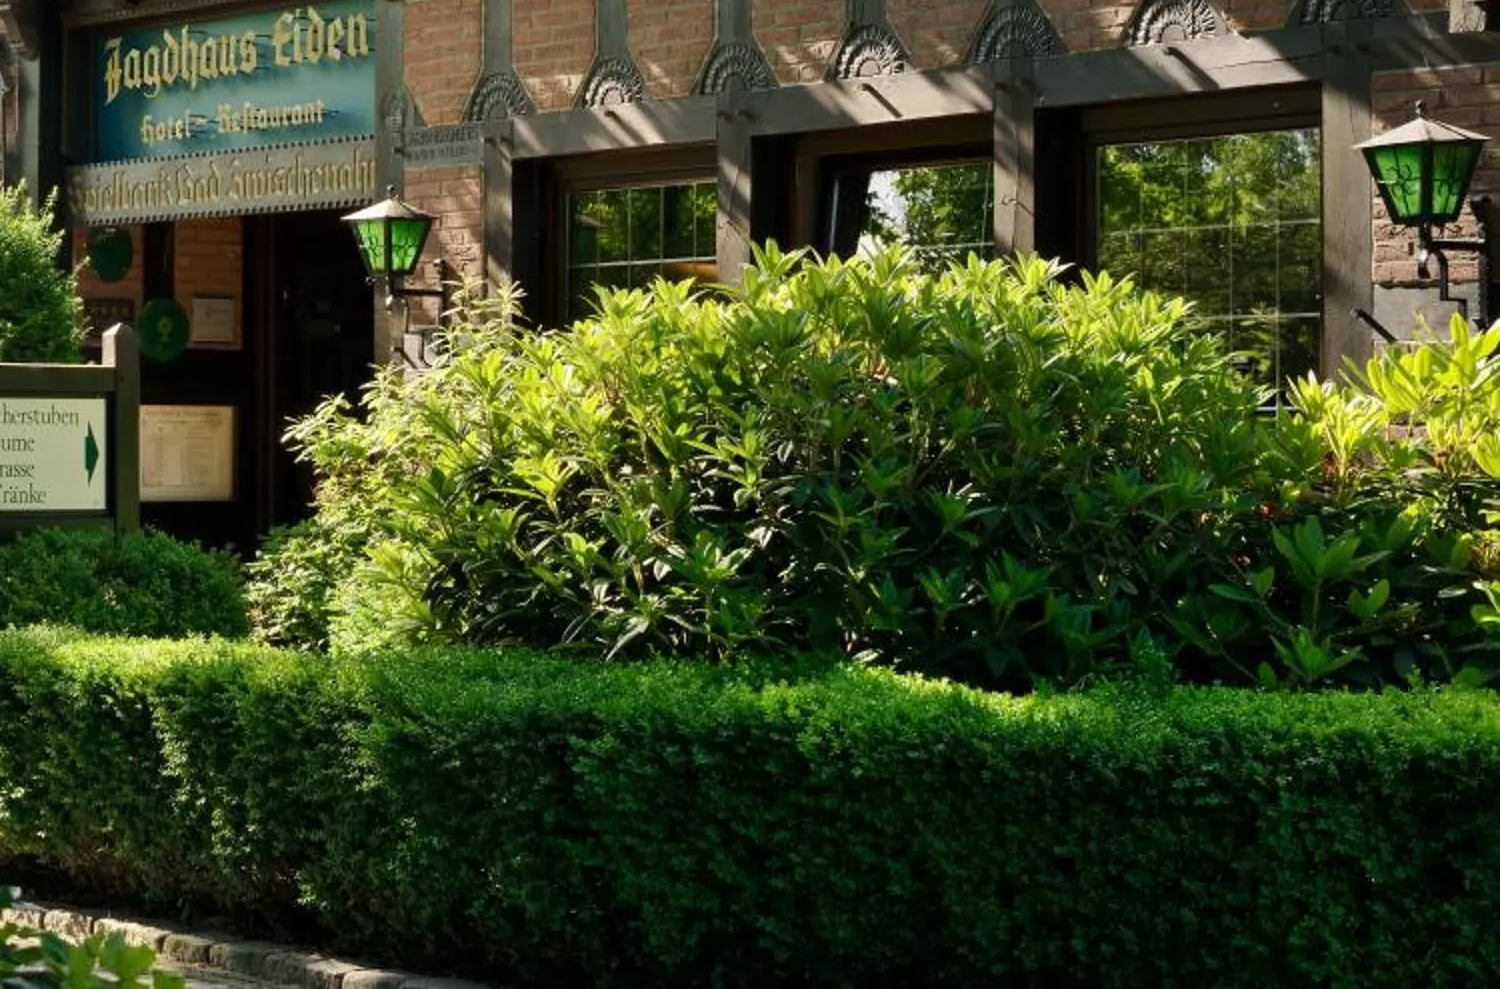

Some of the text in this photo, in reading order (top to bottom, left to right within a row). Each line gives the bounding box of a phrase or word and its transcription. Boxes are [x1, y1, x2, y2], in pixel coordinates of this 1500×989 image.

[104, 6, 370, 106] Jagdhaus Eiden
[140, 108, 191, 145] Hotel
[217, 99, 325, 135] Restaurant
[176, 161, 221, 206] Bad
